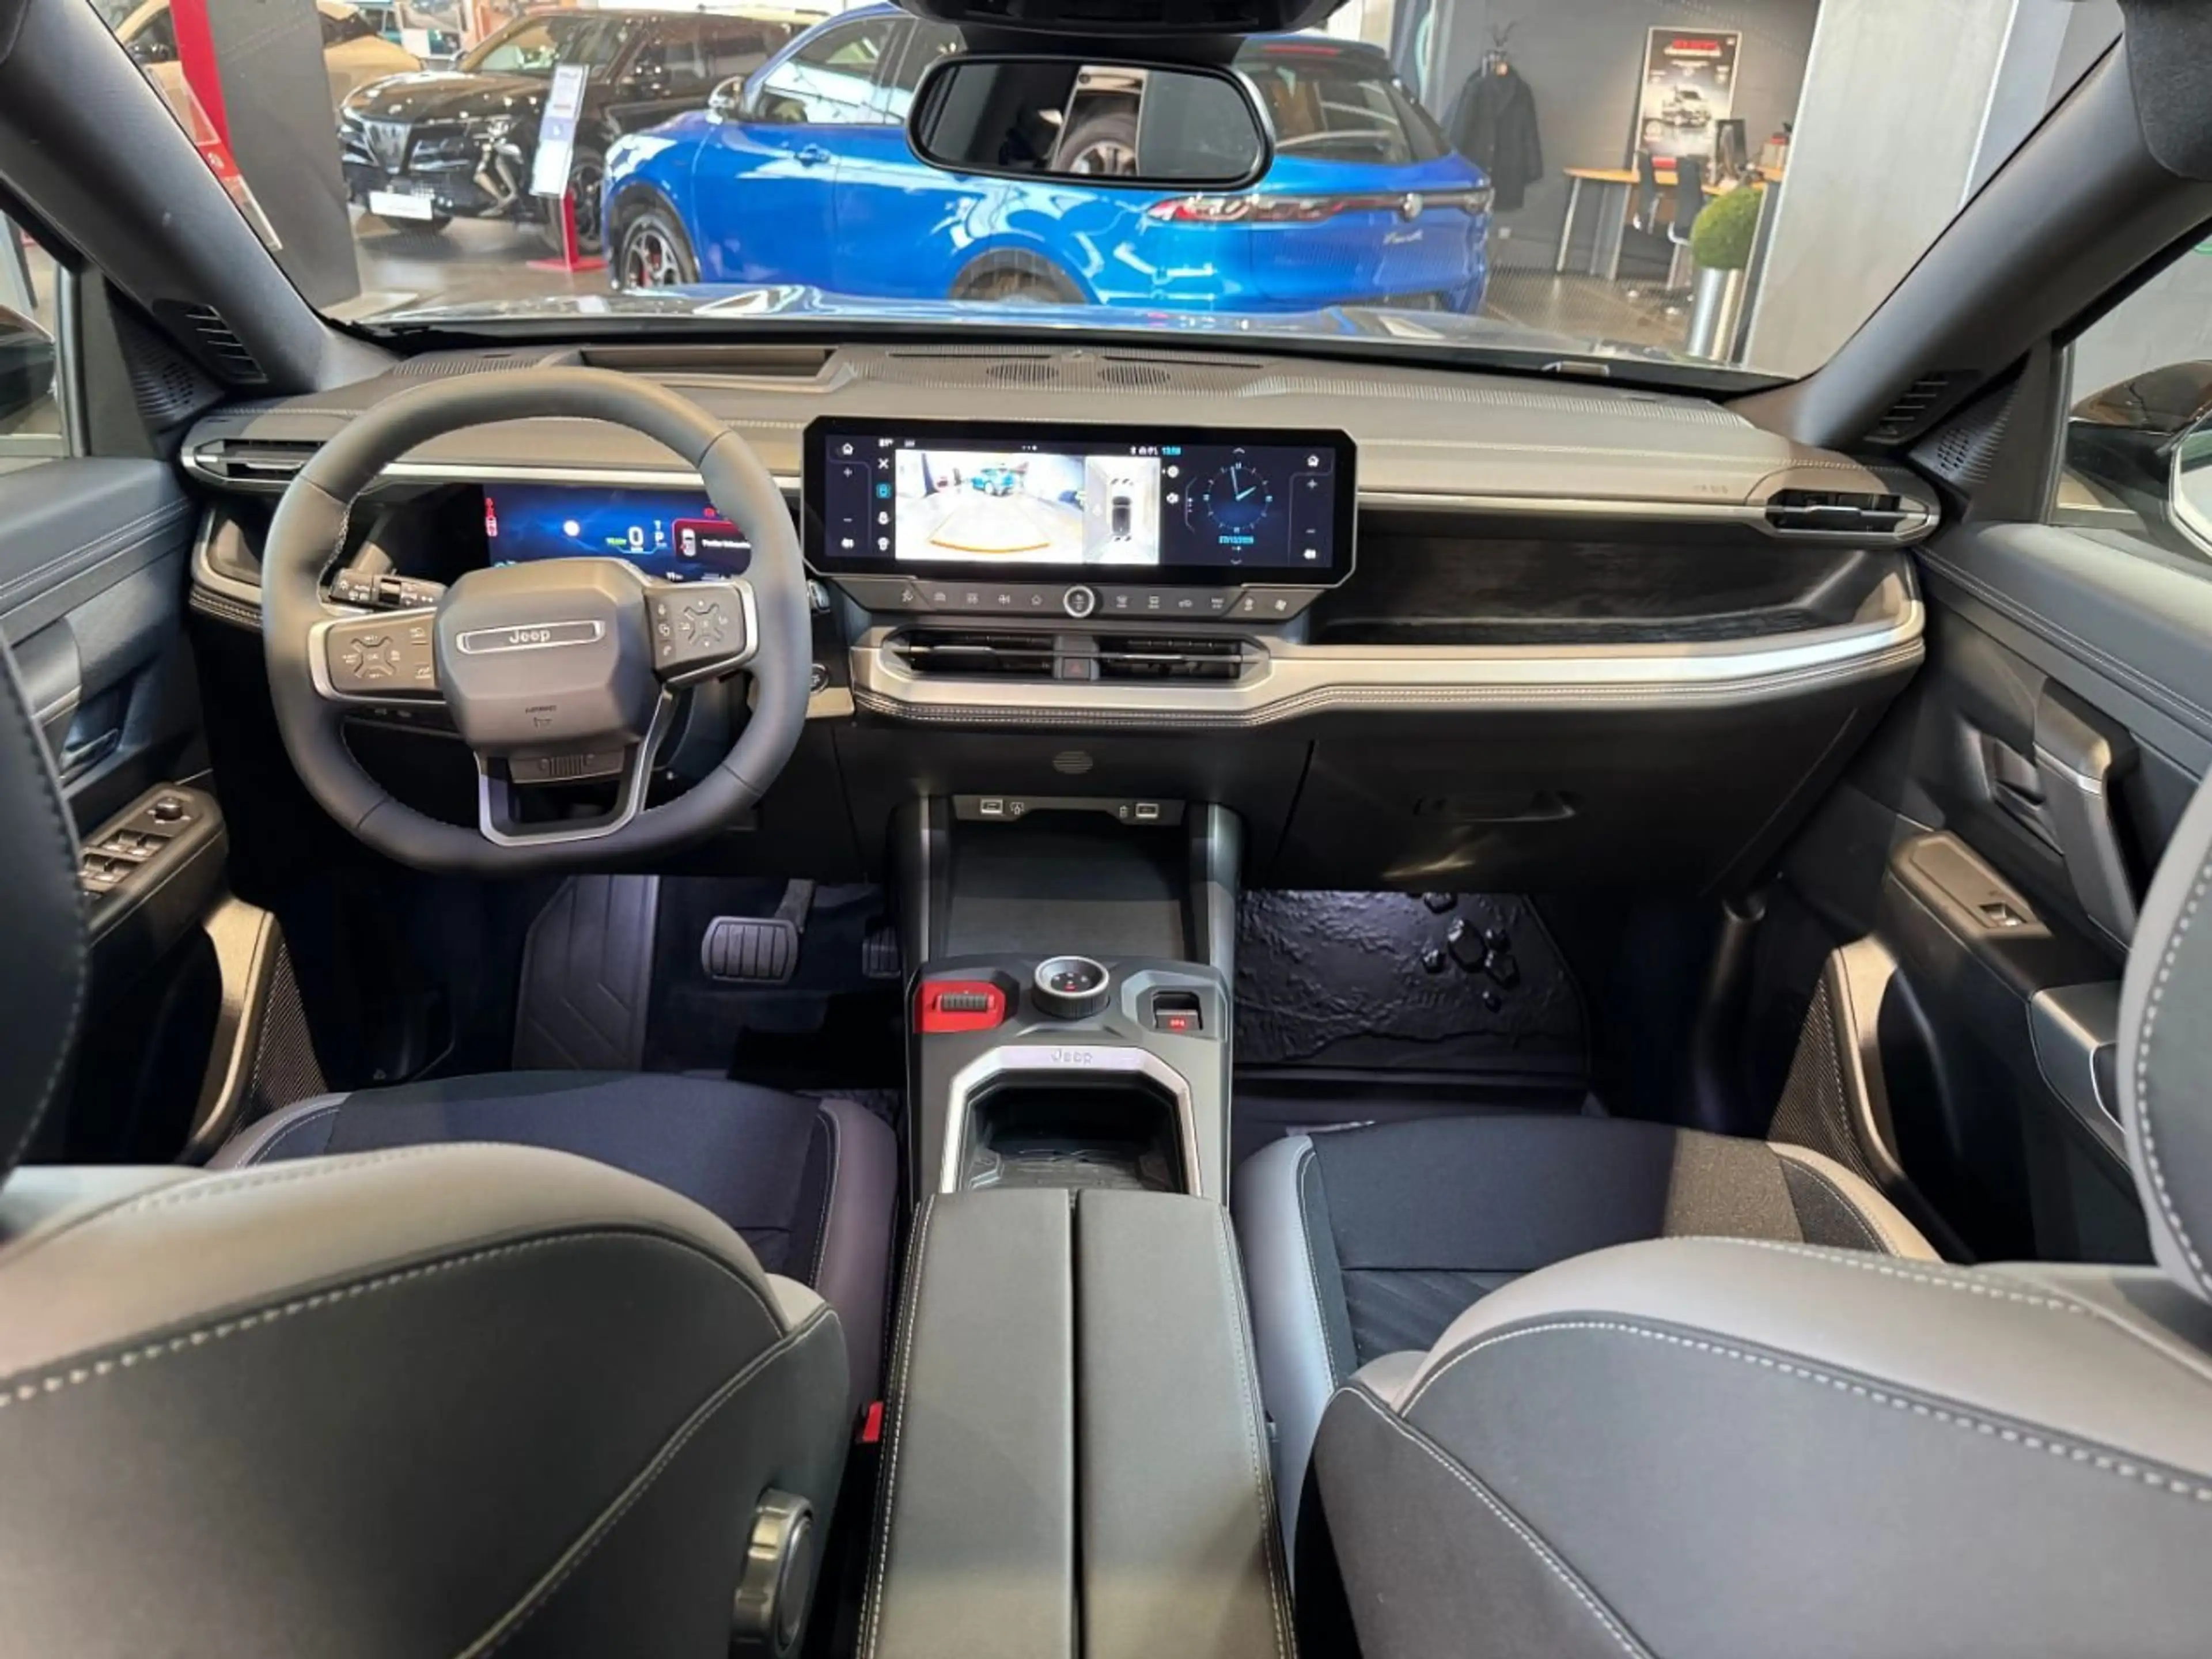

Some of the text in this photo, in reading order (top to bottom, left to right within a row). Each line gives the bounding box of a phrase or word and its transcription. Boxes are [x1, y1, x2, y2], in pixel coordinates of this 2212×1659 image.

[628, 525, 644, 546] 0
[509, 630, 551, 644] Jeep
[1051, 1048, 1093, 1065] Jeep
